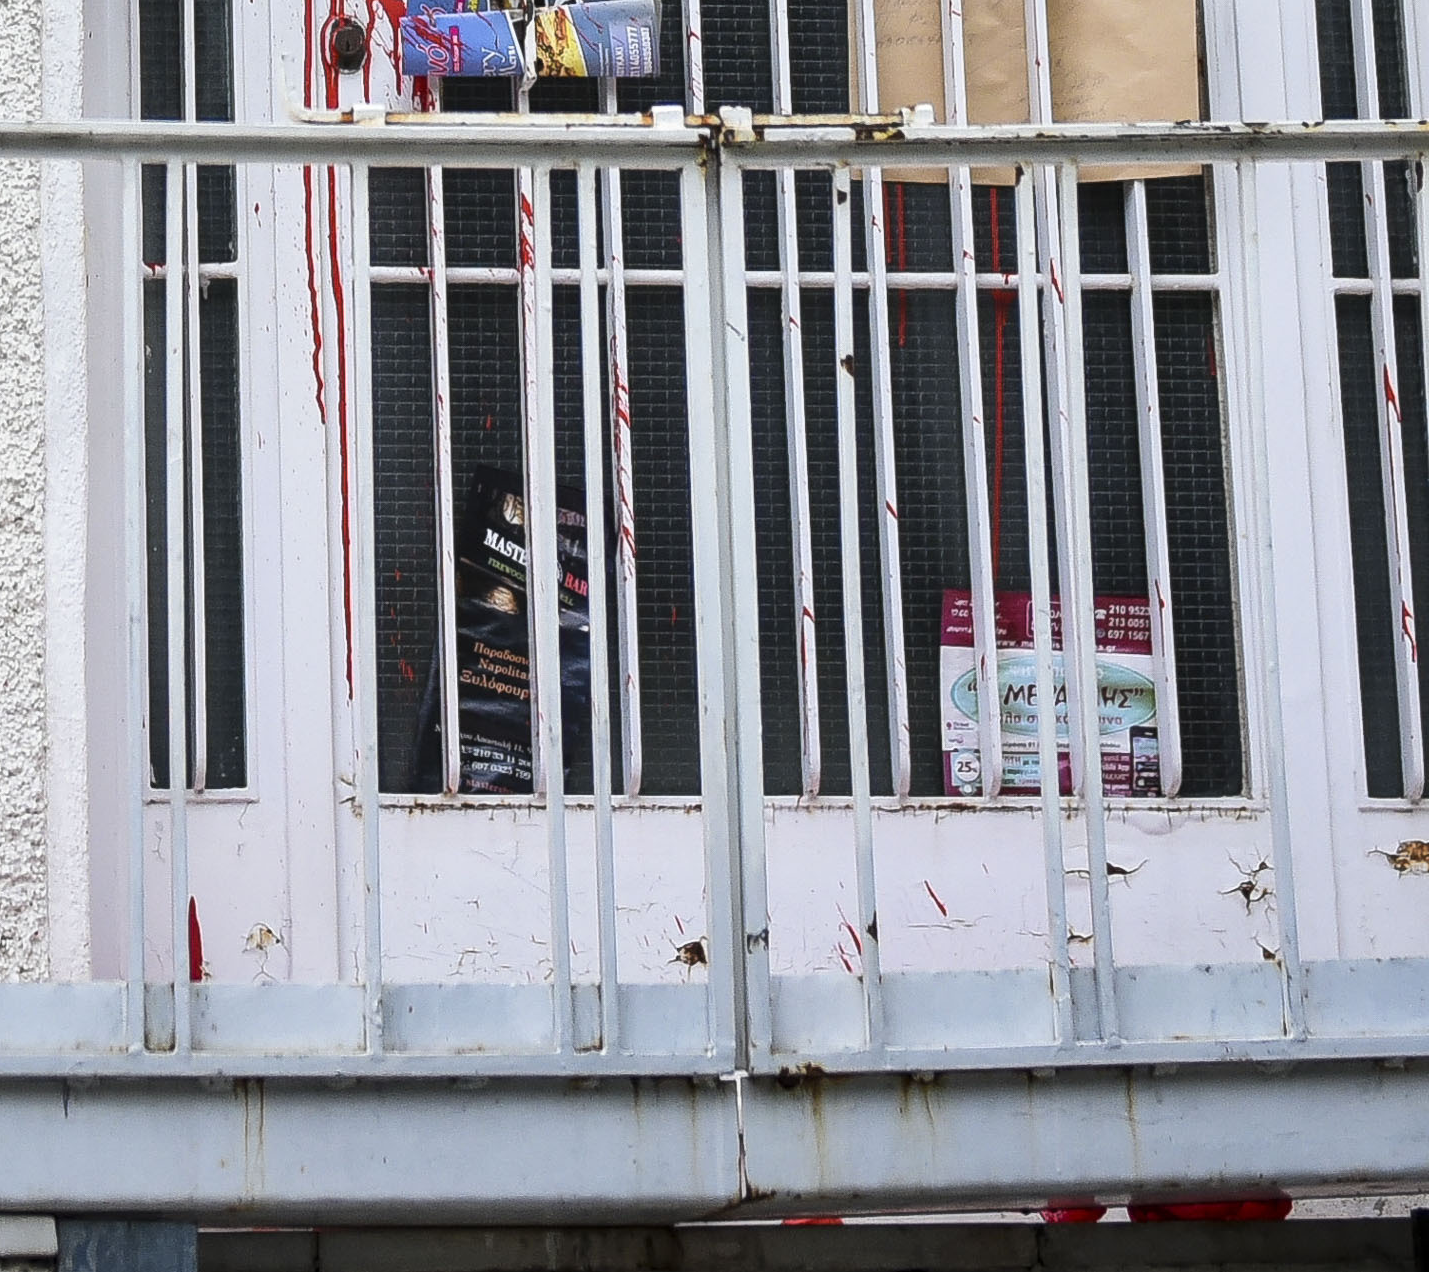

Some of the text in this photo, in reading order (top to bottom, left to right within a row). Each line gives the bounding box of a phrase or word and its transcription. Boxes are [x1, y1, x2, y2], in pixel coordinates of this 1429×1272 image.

[483, 528, 528, 567] MASTE
[565, 572, 589, 596] BAR
[1108, 604, 1151, 616] 210 9523
[1128, 631, 1150, 641] 1567
[478, 658, 530, 680] Napolita
[460, 669, 531, 700] Ξυλόφουρ
